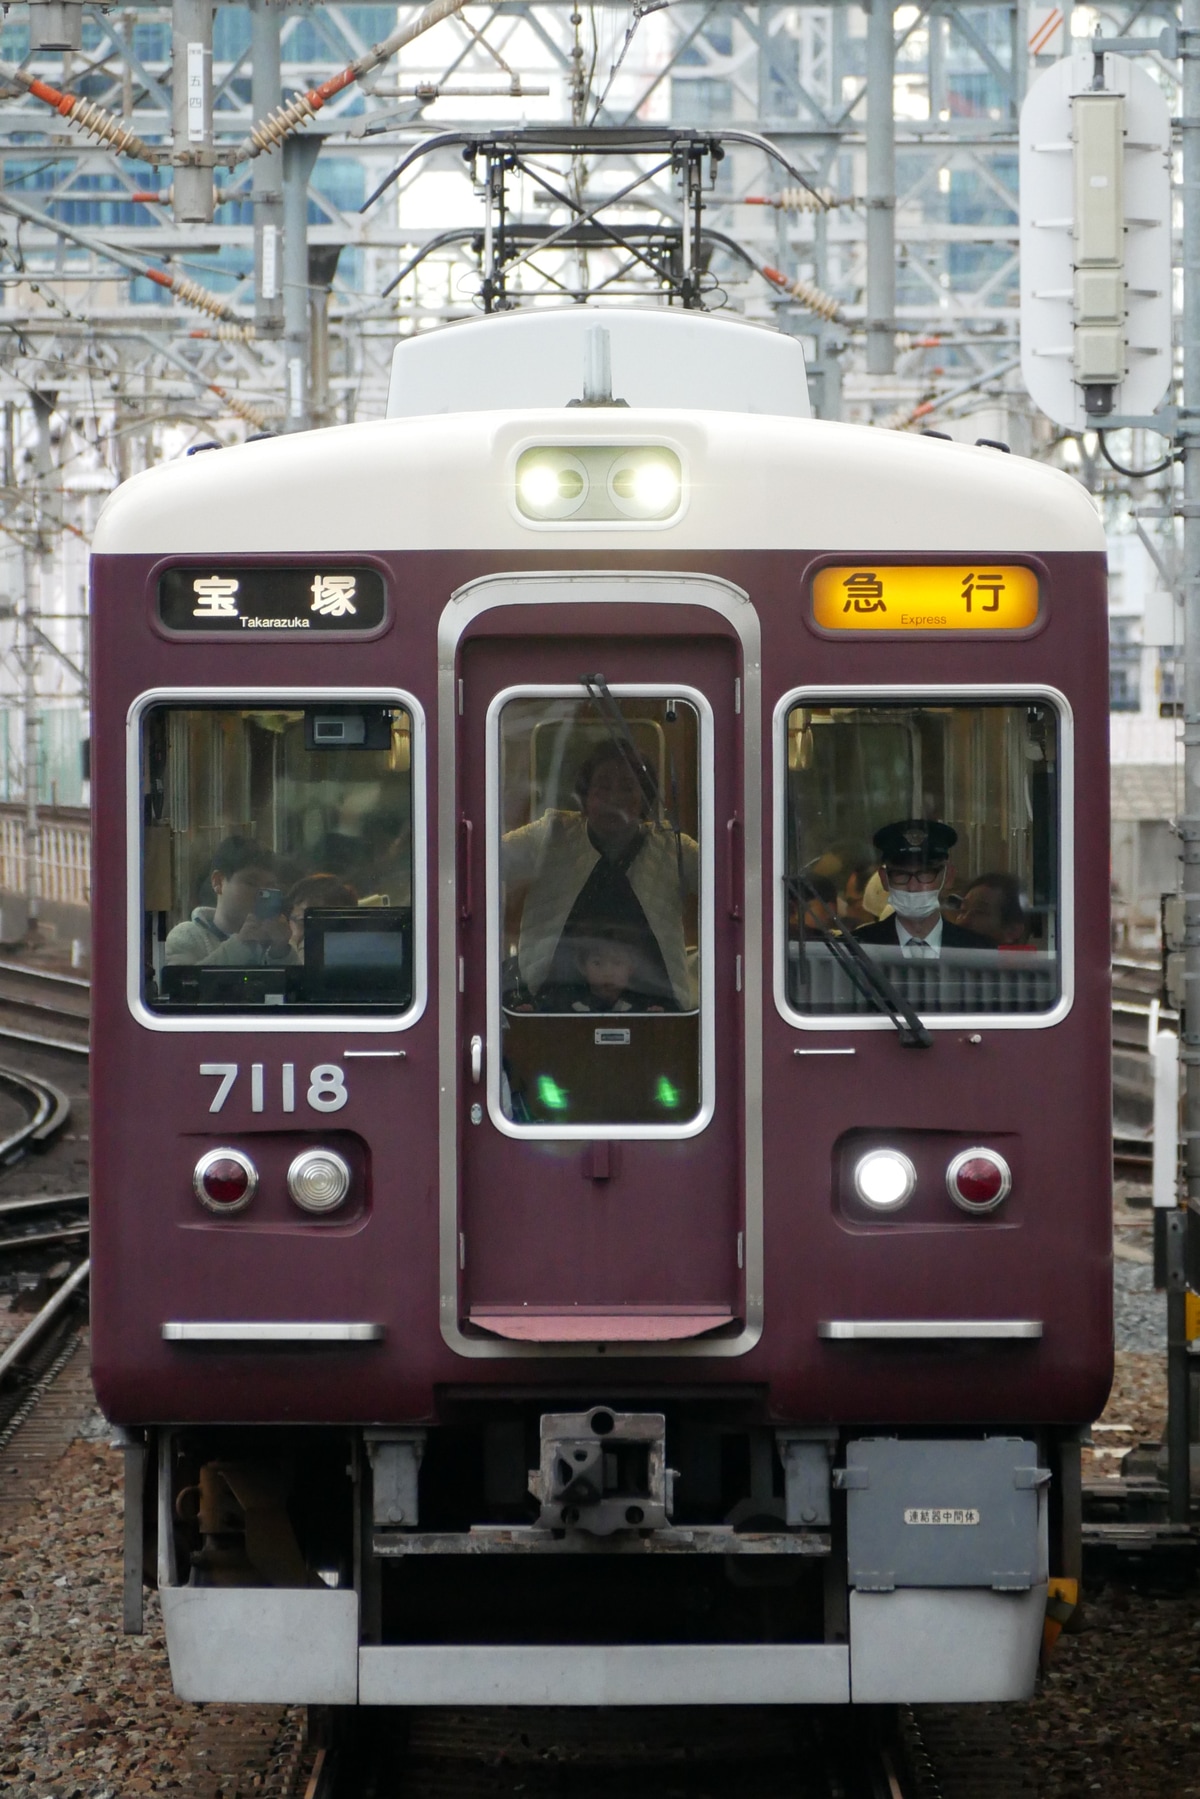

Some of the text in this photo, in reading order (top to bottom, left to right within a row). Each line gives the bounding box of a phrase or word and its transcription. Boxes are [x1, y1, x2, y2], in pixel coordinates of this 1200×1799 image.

[193, 575, 357, 616] 宝塚
[842, 572, 1006, 613] 急行
[239, 616, 310, 628] Takarazuka
[900, 614, 947, 625] Express
[199, 1063, 348, 1113] 7118
